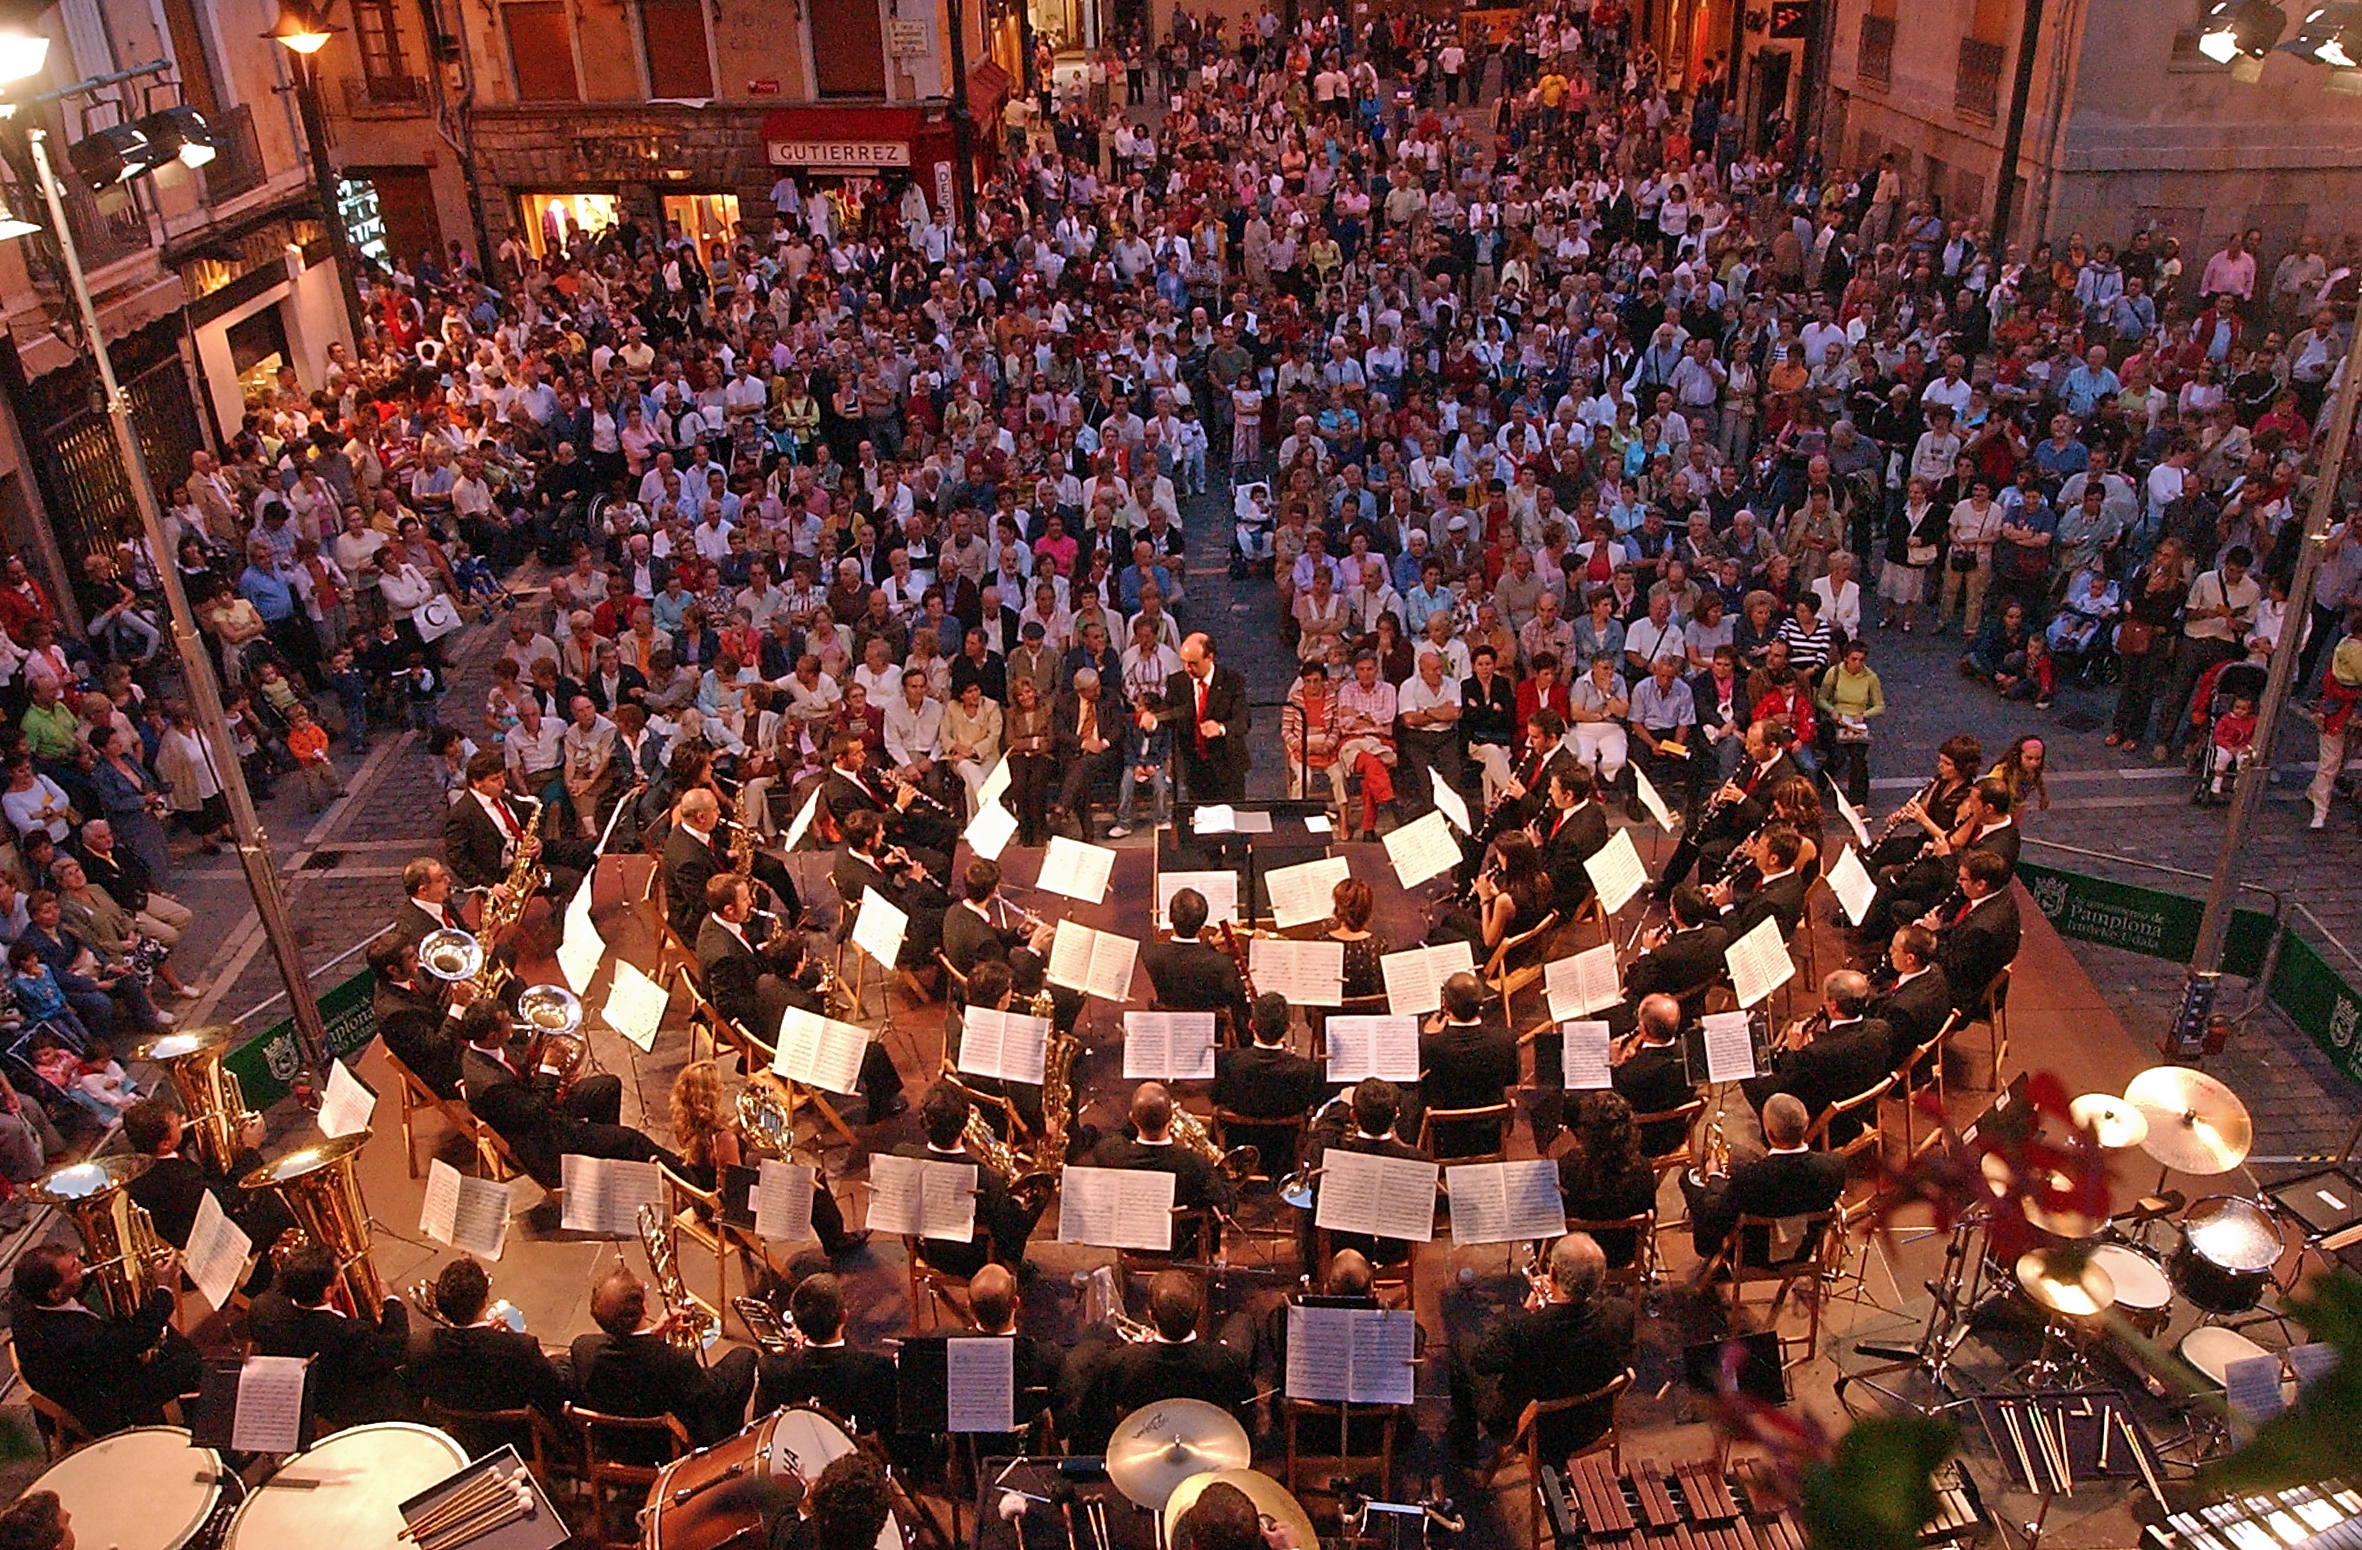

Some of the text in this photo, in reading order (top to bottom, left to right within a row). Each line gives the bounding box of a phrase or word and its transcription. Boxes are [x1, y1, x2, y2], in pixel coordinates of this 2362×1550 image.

[780, 145, 898, 160] GUTIERREZ
[424, 604, 448, 627] C
[2071, 903, 2162, 938] Pamplona
